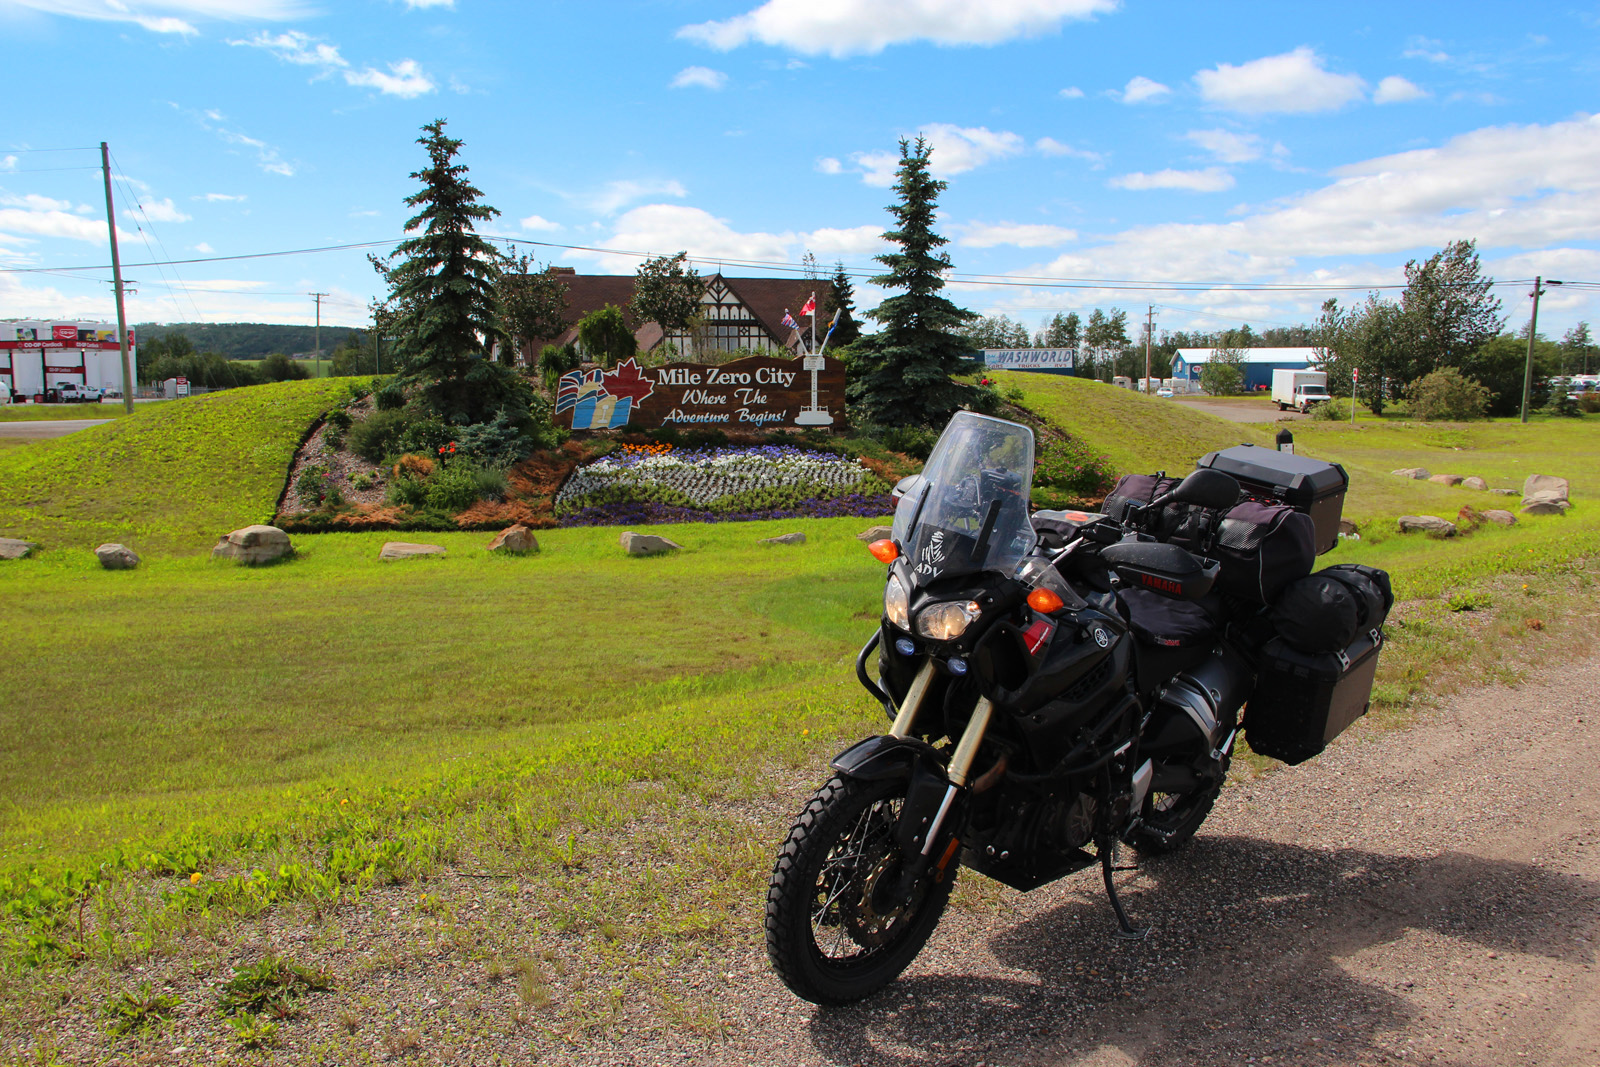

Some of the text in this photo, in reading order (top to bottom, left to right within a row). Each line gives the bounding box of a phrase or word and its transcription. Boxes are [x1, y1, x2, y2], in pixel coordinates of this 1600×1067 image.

[998, 351, 1072, 363] WASHWORLD
[657, 367, 797, 388] Mile Zero City
[681, 388, 768, 405] Where The
[661, 408, 787, 427] Adventure Begins!
[914, 561, 944, 579] ADV
[1141, 573, 1182, 595] YAMAHA
